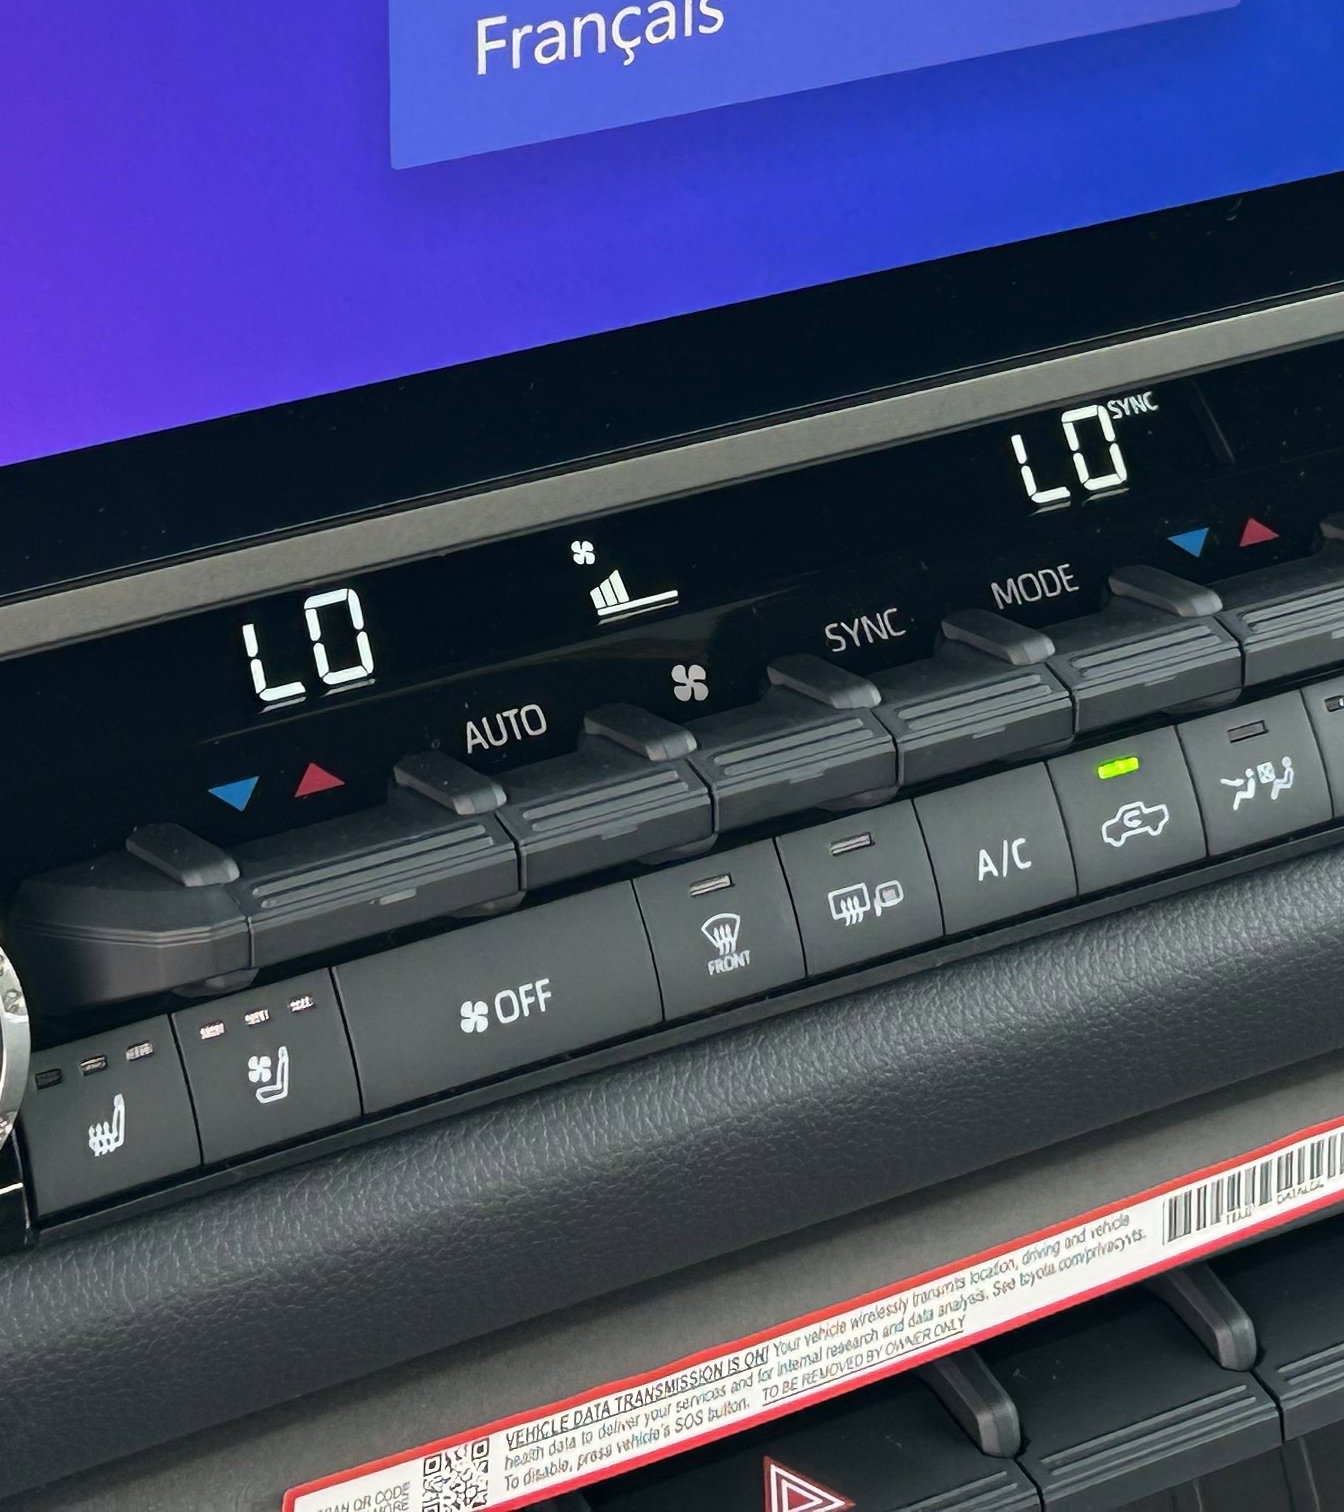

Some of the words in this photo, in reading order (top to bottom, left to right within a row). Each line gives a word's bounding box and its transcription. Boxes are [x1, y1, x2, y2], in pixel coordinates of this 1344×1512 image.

[1107, 391, 1159, 421] SYNC
[1011, 403, 1128, 504] LO
[991, 564, 1079, 609] MODE
[242, 588, 374, 702] LO
[824, 608, 906, 653] SYNC
[464, 703, 548, 754] AUTO
[977, 838, 1032, 881] A/C
[707, 949, 751, 976] FRONT
[493, 978, 553, 1025] OFF
[506, 1414, 569, 1450] VEHICLE
[574, 1400, 610, 1426] DATA
[615, 1361, 723, 1412] TRANSMISSION
[728, 1357, 740, 1373] IS
[744, 1345, 769, 1368] ON!
[773, 1338, 802, 1358] Your
[804, 1320, 847, 1346] vehicle
[851, 1297, 908, 1328] wirelessly
[913, 1277, 966, 1307] transmits
[969, 1258, 1018, 1284] location,
[1022, 1241, 1060, 1266] driving
[1065, 1227, 1086, 1248] and
[1090, 1213, 1130, 1239] vehicle
[505, 1442, 544, 1471] health
[549, 1437, 576, 1456] data
[581, 1430, 593, 1445] to
[598, 1415, 641, 1438] deliver
[644, 1403, 672, 1427] your
[676, 1385, 727, 1413] services
[730, 1371, 754, 1394] and
[757, 1366, 774, 1383] for
[777, 1345, 823, 1377] internal
[826, 1328, 878, 1358] research
[882, 1318, 905, 1337] and
[908, 1308, 934, 1328] data
[938, 1289, 989, 1318] analysis.
[993, 1277, 1016, 1297] See
[762, 1385, 778, 1403] TO
[782, 1378, 798, 1395] BE
[802, 1354, 864, 1386] REMOVED
[866, 1344, 883, 1363] BY
[885, 1327, 931, 1356] OWNER
[934, 1314, 966, 1338] ONLY
[504, 1474, 519, 1491] To
[523, 1456, 573, 1486] disable,
[577, 1443, 612, 1471] press
[617, 1423, 670, 1454] vehicle's
[674, 1410, 704, 1434] SOS
[708, 1397, 750, 1422] button.
[353, 1494, 371, 1511] QR
[375, 1481, 411, 1505] CODE
